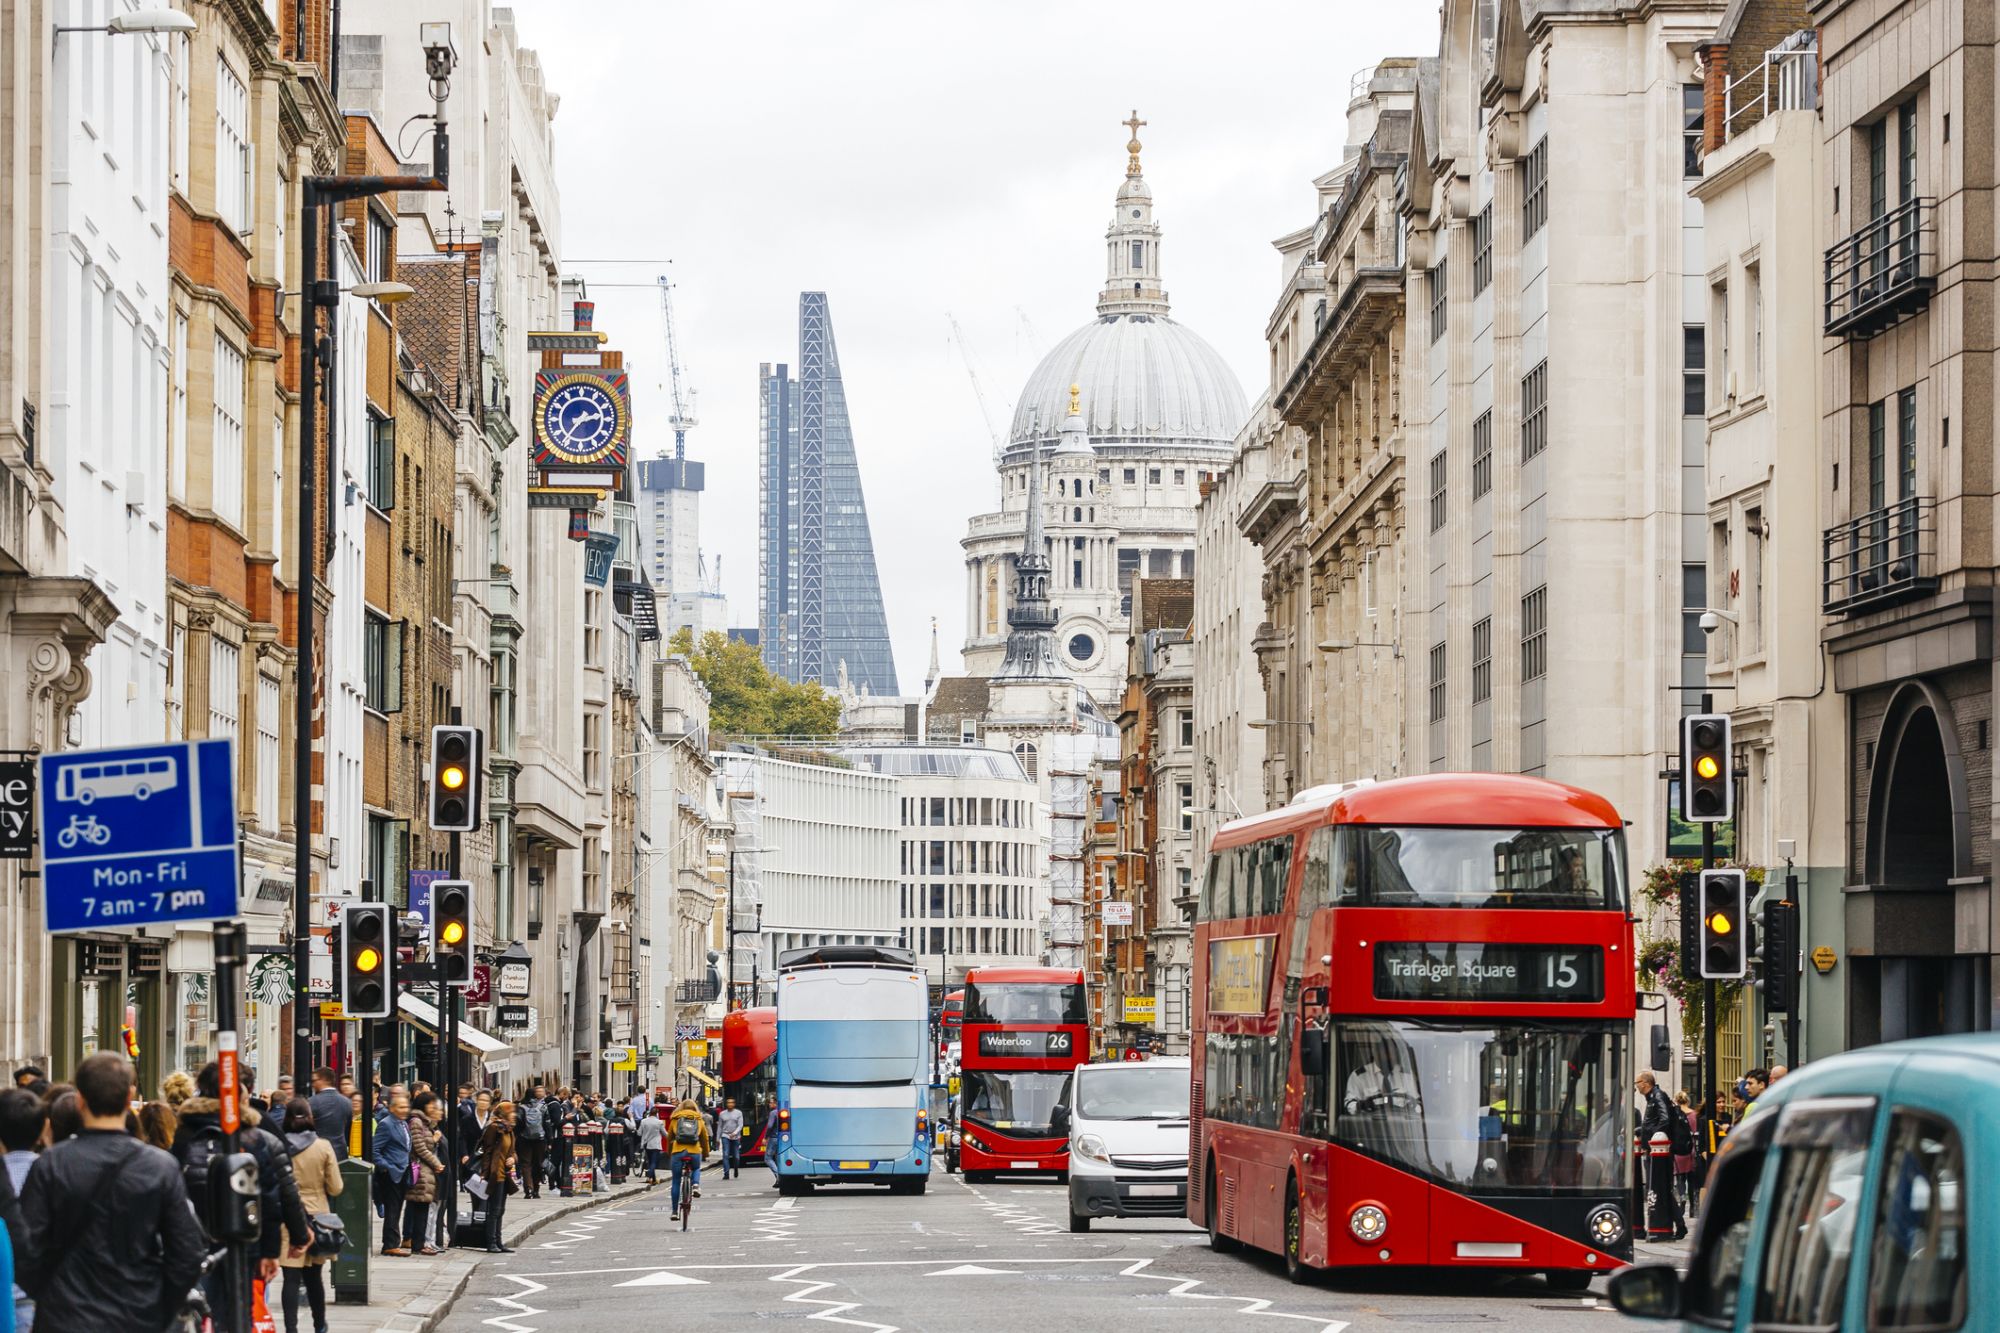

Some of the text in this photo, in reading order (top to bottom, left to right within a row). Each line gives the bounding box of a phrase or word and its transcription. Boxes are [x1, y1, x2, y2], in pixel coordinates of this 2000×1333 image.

[0, 779, 28, 806] e
[1389, 959, 1516, 982] Trafalgar Square
[1546, 954, 1578, 988] 15
[986, 1036, 1032, 1046] Waterloo
[1048, 1033, 1069, 1049] 26
